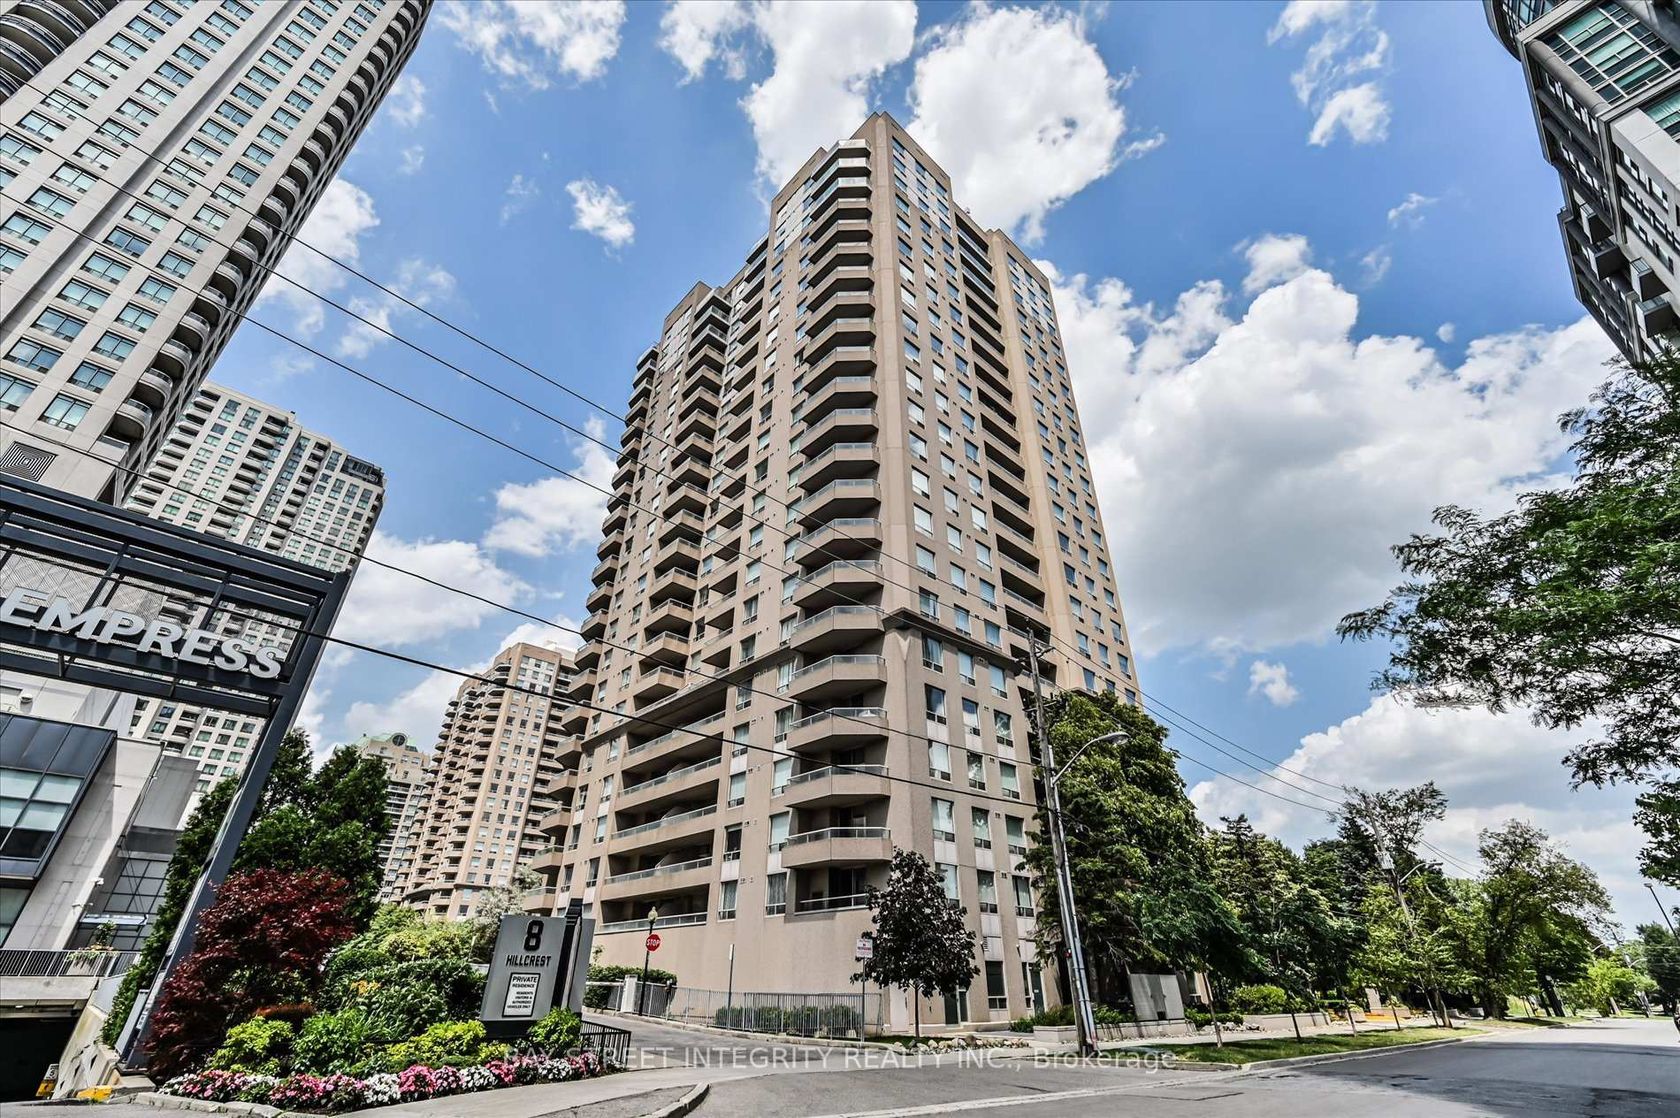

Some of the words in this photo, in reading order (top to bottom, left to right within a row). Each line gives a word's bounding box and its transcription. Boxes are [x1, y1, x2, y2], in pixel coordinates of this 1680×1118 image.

[0, 586, 282, 678] EMPRESS
[524, 920, 544, 951] 8
[646, 938, 661, 946] STOP
[506, 954, 551, 967] HILLCREST
